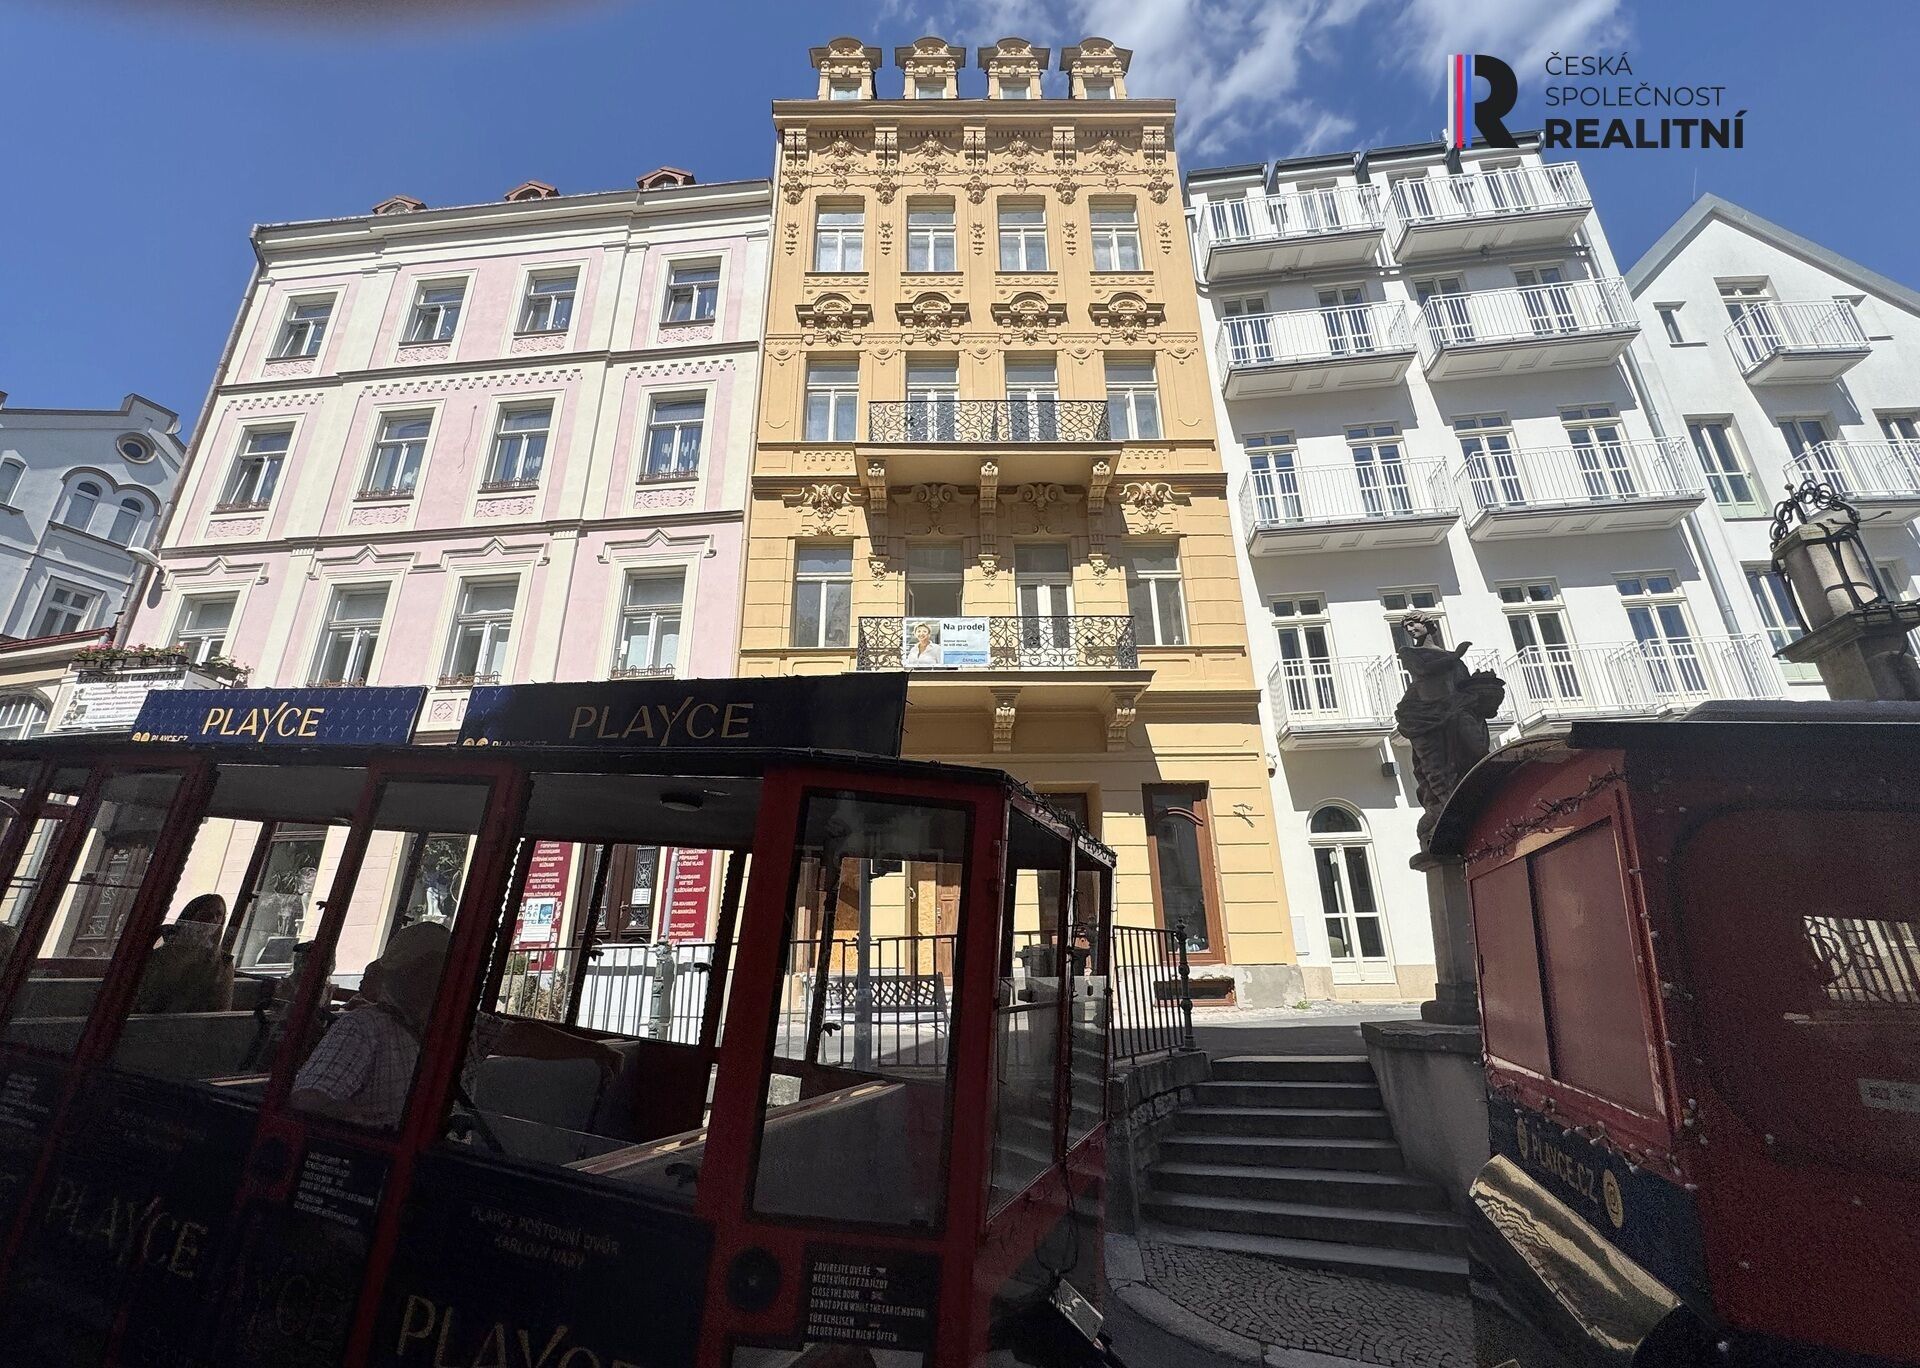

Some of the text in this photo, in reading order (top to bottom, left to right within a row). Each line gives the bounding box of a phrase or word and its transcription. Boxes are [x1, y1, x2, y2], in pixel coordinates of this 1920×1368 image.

[957, 623, 985, 632] prodej
[202, 702, 326, 742] PLAYCE
[568, 696, 754, 747] PLAYCE
[1531, 1133, 1598, 1205] PLAYCE.CZ
[45, 1176, 209, 1279] PLAYCE
[518, 1216, 581, 1246] POŠTOVNÍ
[810, 1297, 819, 1308] DO
[819, 1298, 832, 1310] NOT
[832, 1300, 849, 1311] OPEN
[869, 1303, 881, 1314] THE
[881, 1304, 894, 1315] CAR
[811, 1286, 860, 1300] CLOSE THE DOOR
[396, 1294, 642, 1368] PLAY
